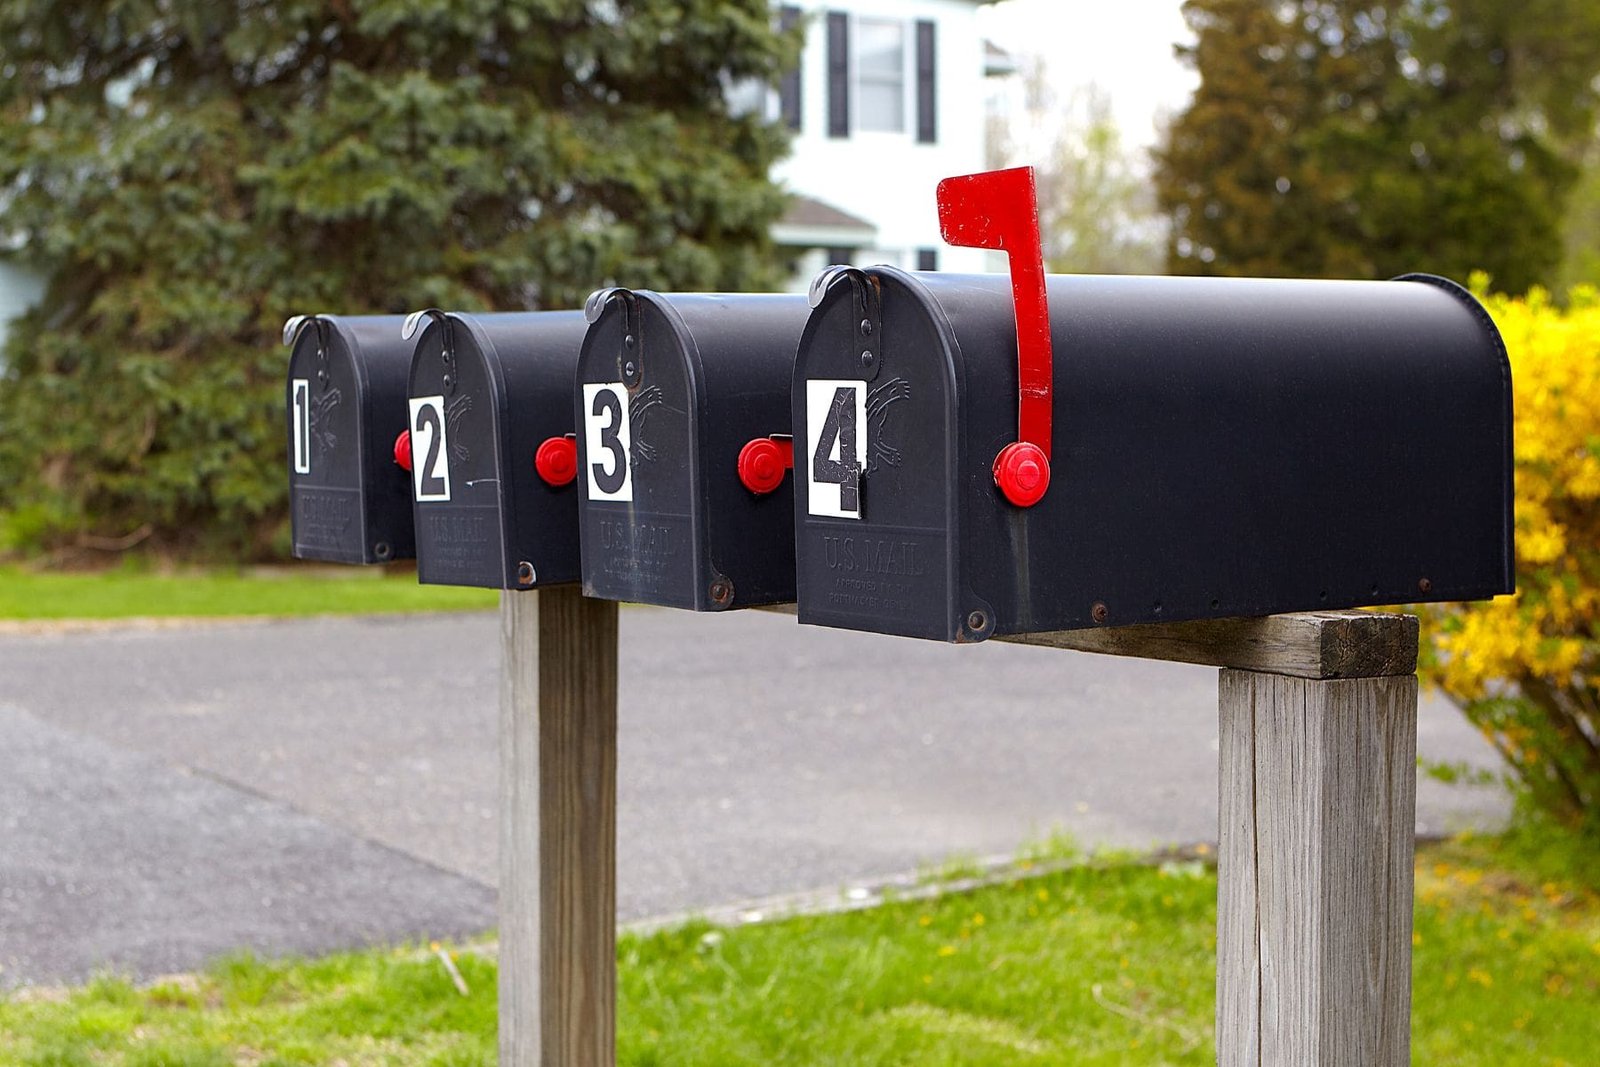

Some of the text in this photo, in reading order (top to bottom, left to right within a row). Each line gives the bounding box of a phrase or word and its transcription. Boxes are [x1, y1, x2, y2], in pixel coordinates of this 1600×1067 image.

[296, 386, 307, 467] 1
[417, 404, 446, 495] 2
[592, 388, 627, 494] 3
[813, 387, 861, 511] 4
[823, 536, 924, 576] U.S. MAIL
